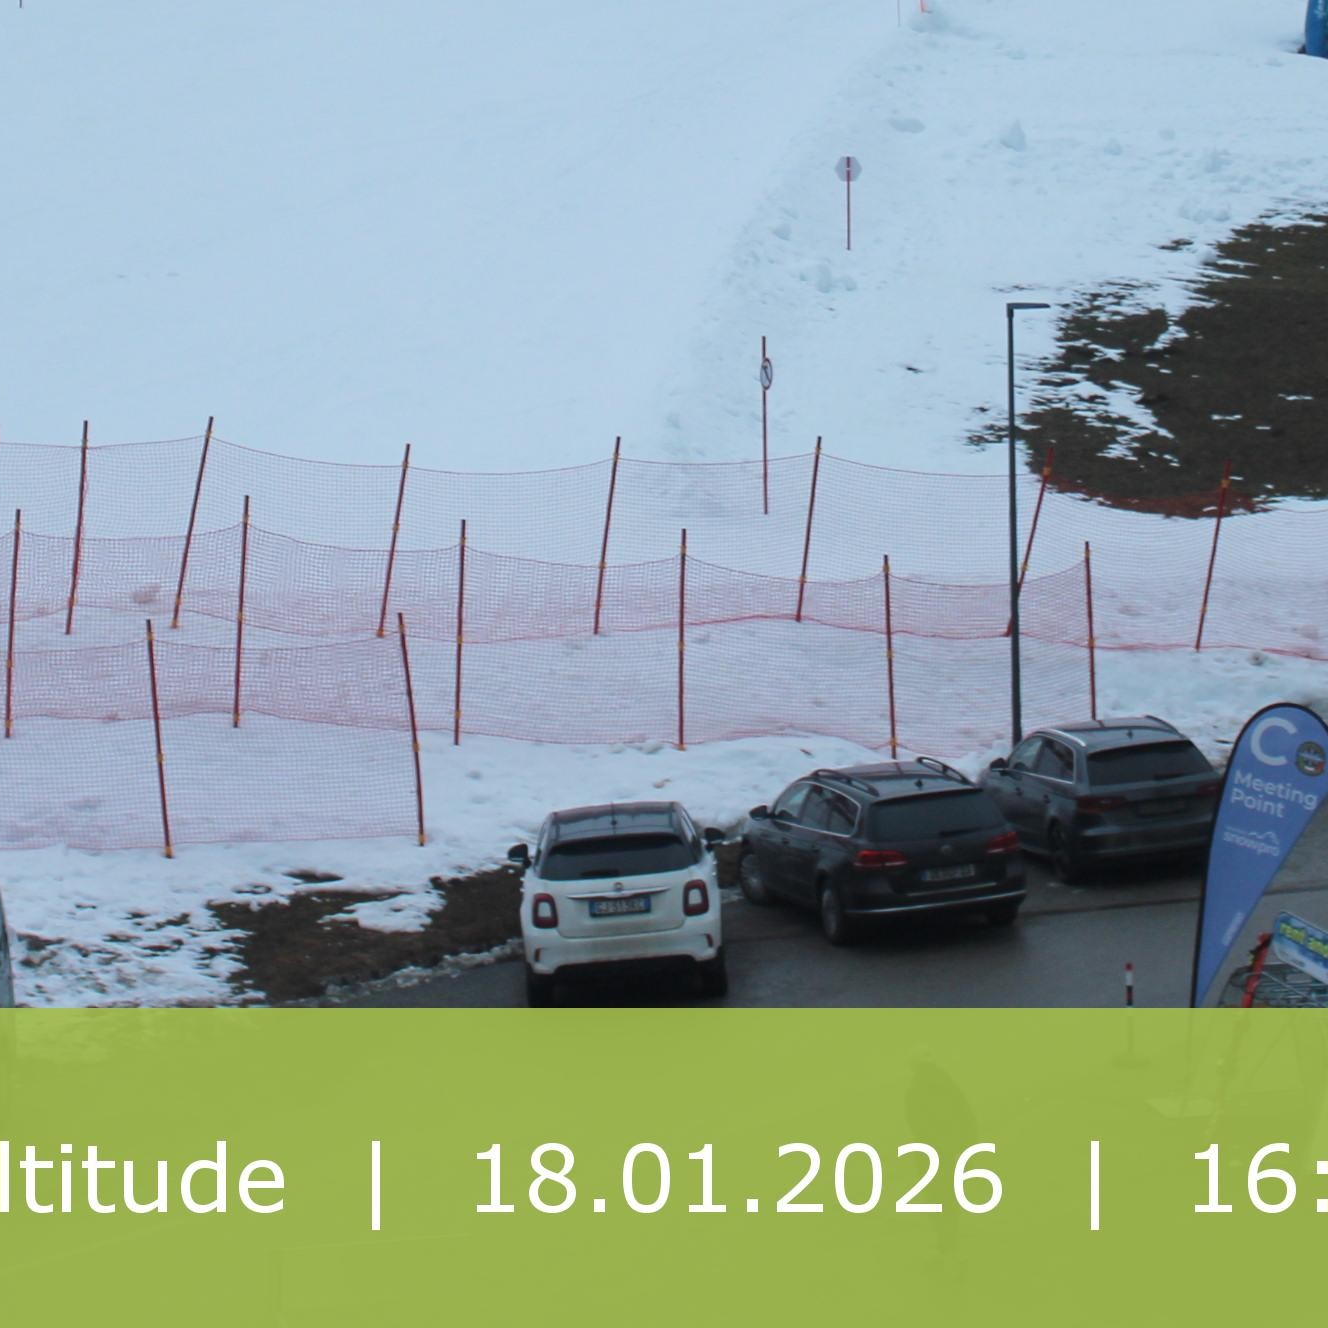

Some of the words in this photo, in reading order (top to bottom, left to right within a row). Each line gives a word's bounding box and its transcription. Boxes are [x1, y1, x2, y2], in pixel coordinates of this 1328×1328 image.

[1250, 716, 1298, 767] C
[1230, 787, 1285, 819] Point
[1233, 769, 1318, 811] Meeting
[1279, 922, 1307, 945] rent
